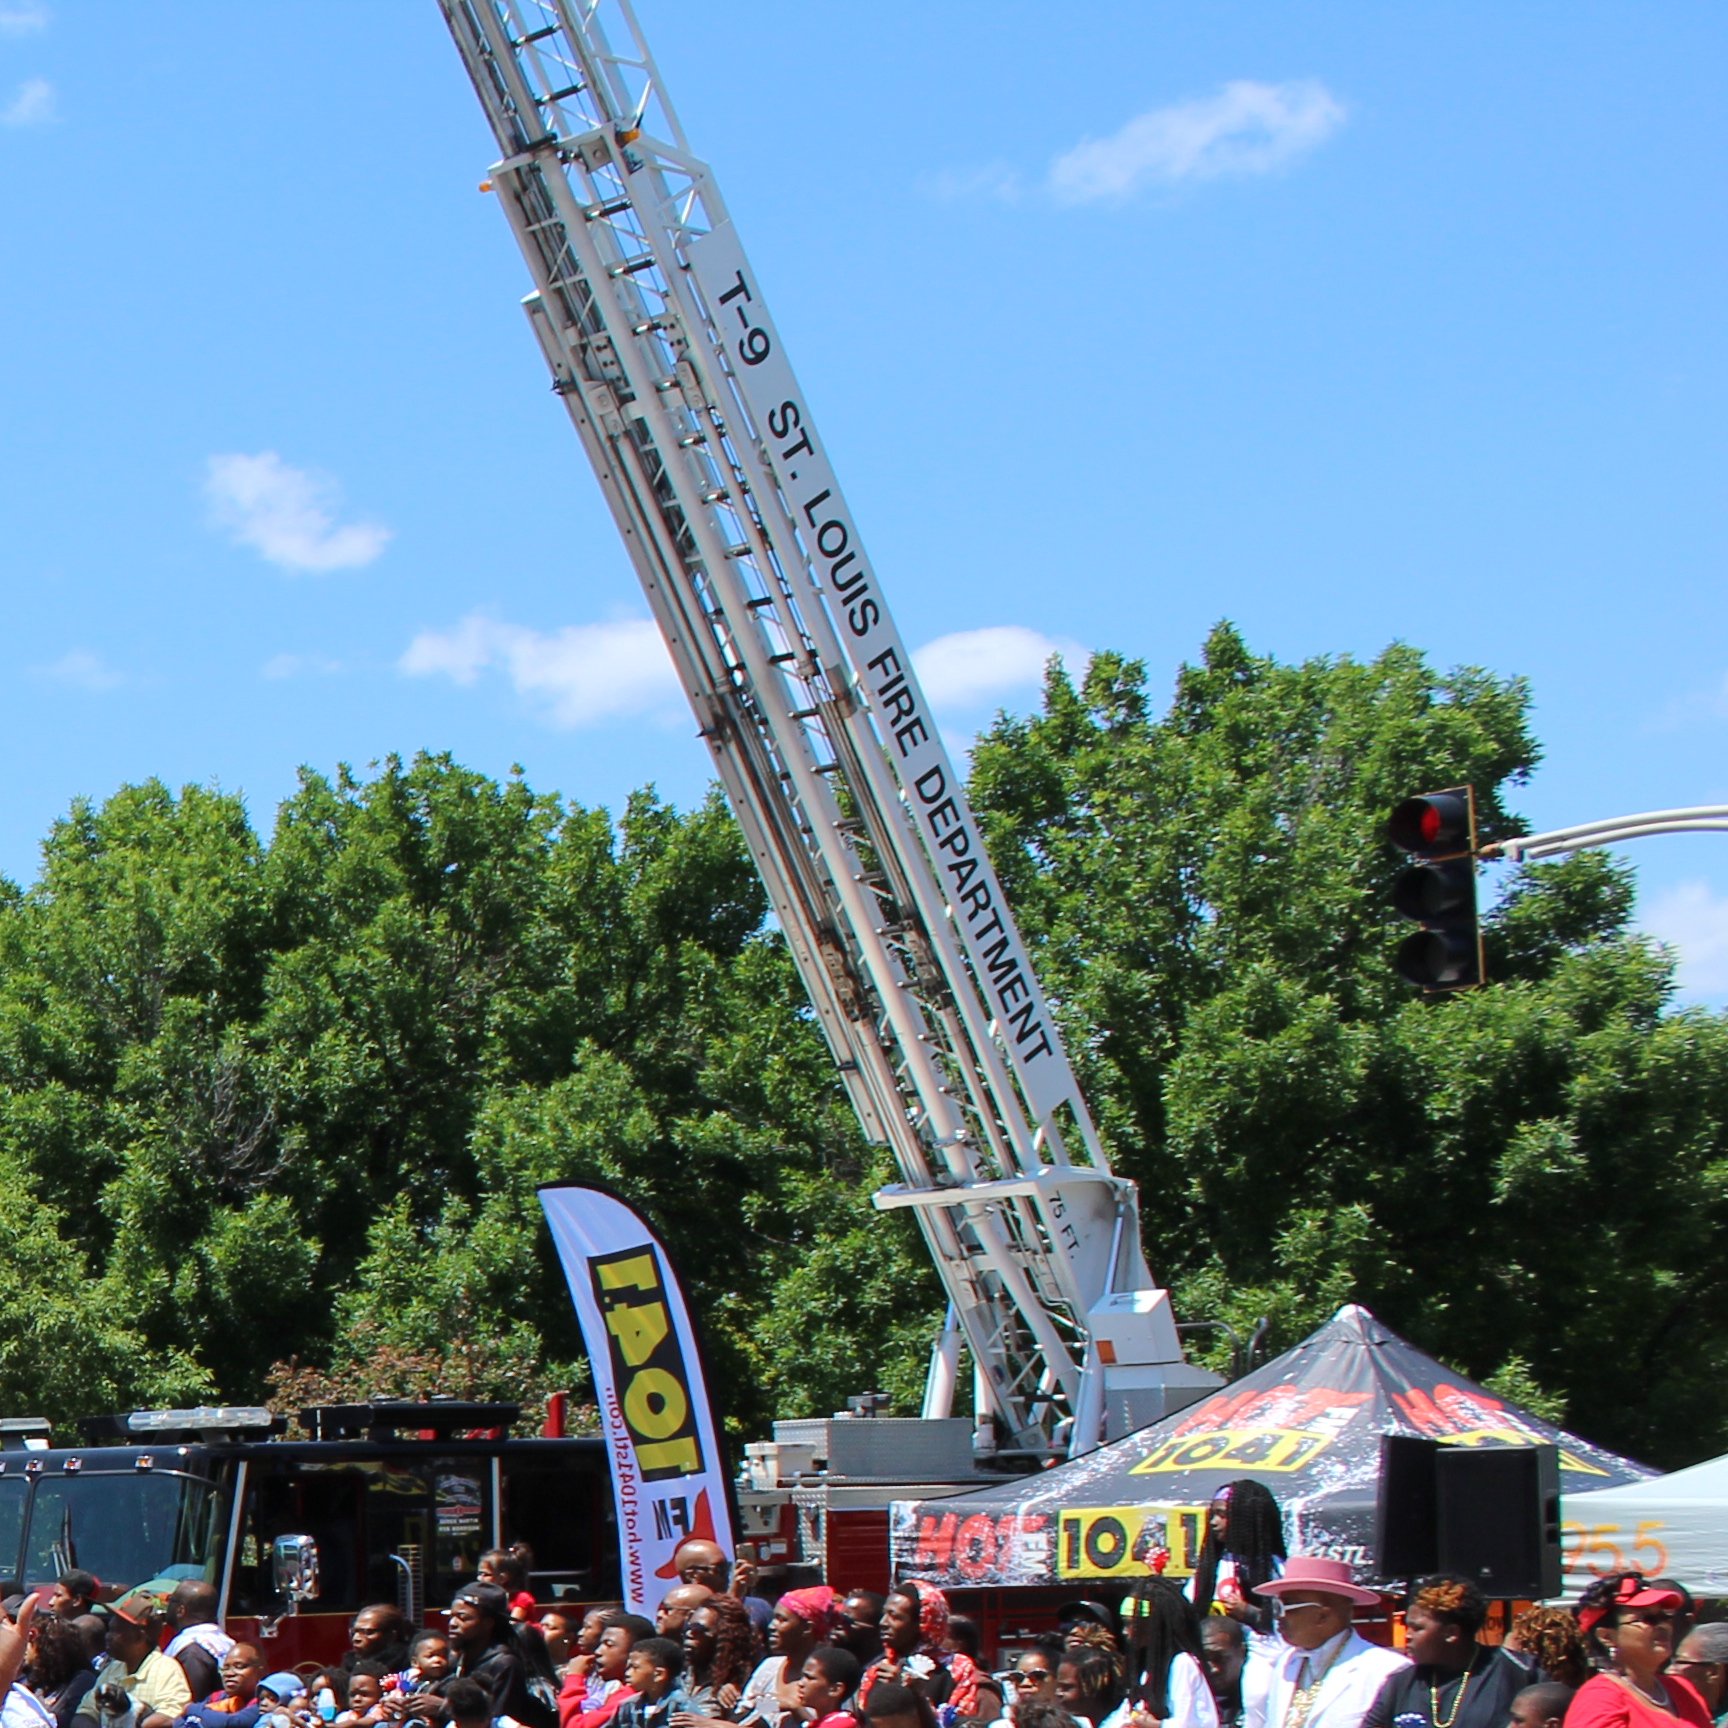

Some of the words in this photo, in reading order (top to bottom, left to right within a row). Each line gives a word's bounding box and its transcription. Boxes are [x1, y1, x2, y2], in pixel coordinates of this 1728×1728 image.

[717, 269, 772, 367] T-9
[767, 400, 815, 481] ST.
[801, 488, 881, 638] LOUIS
[866, 646, 931, 759] FIRE
[913, 764, 1054, 1065] DEPARTMENT
[1049, 1190, 1067, 1219] 75
[1061, 1223, 1080, 1259] FT.
[1174, 1384, 1375, 1437] HOT
[916, 1512, 1049, 1579] HOT
